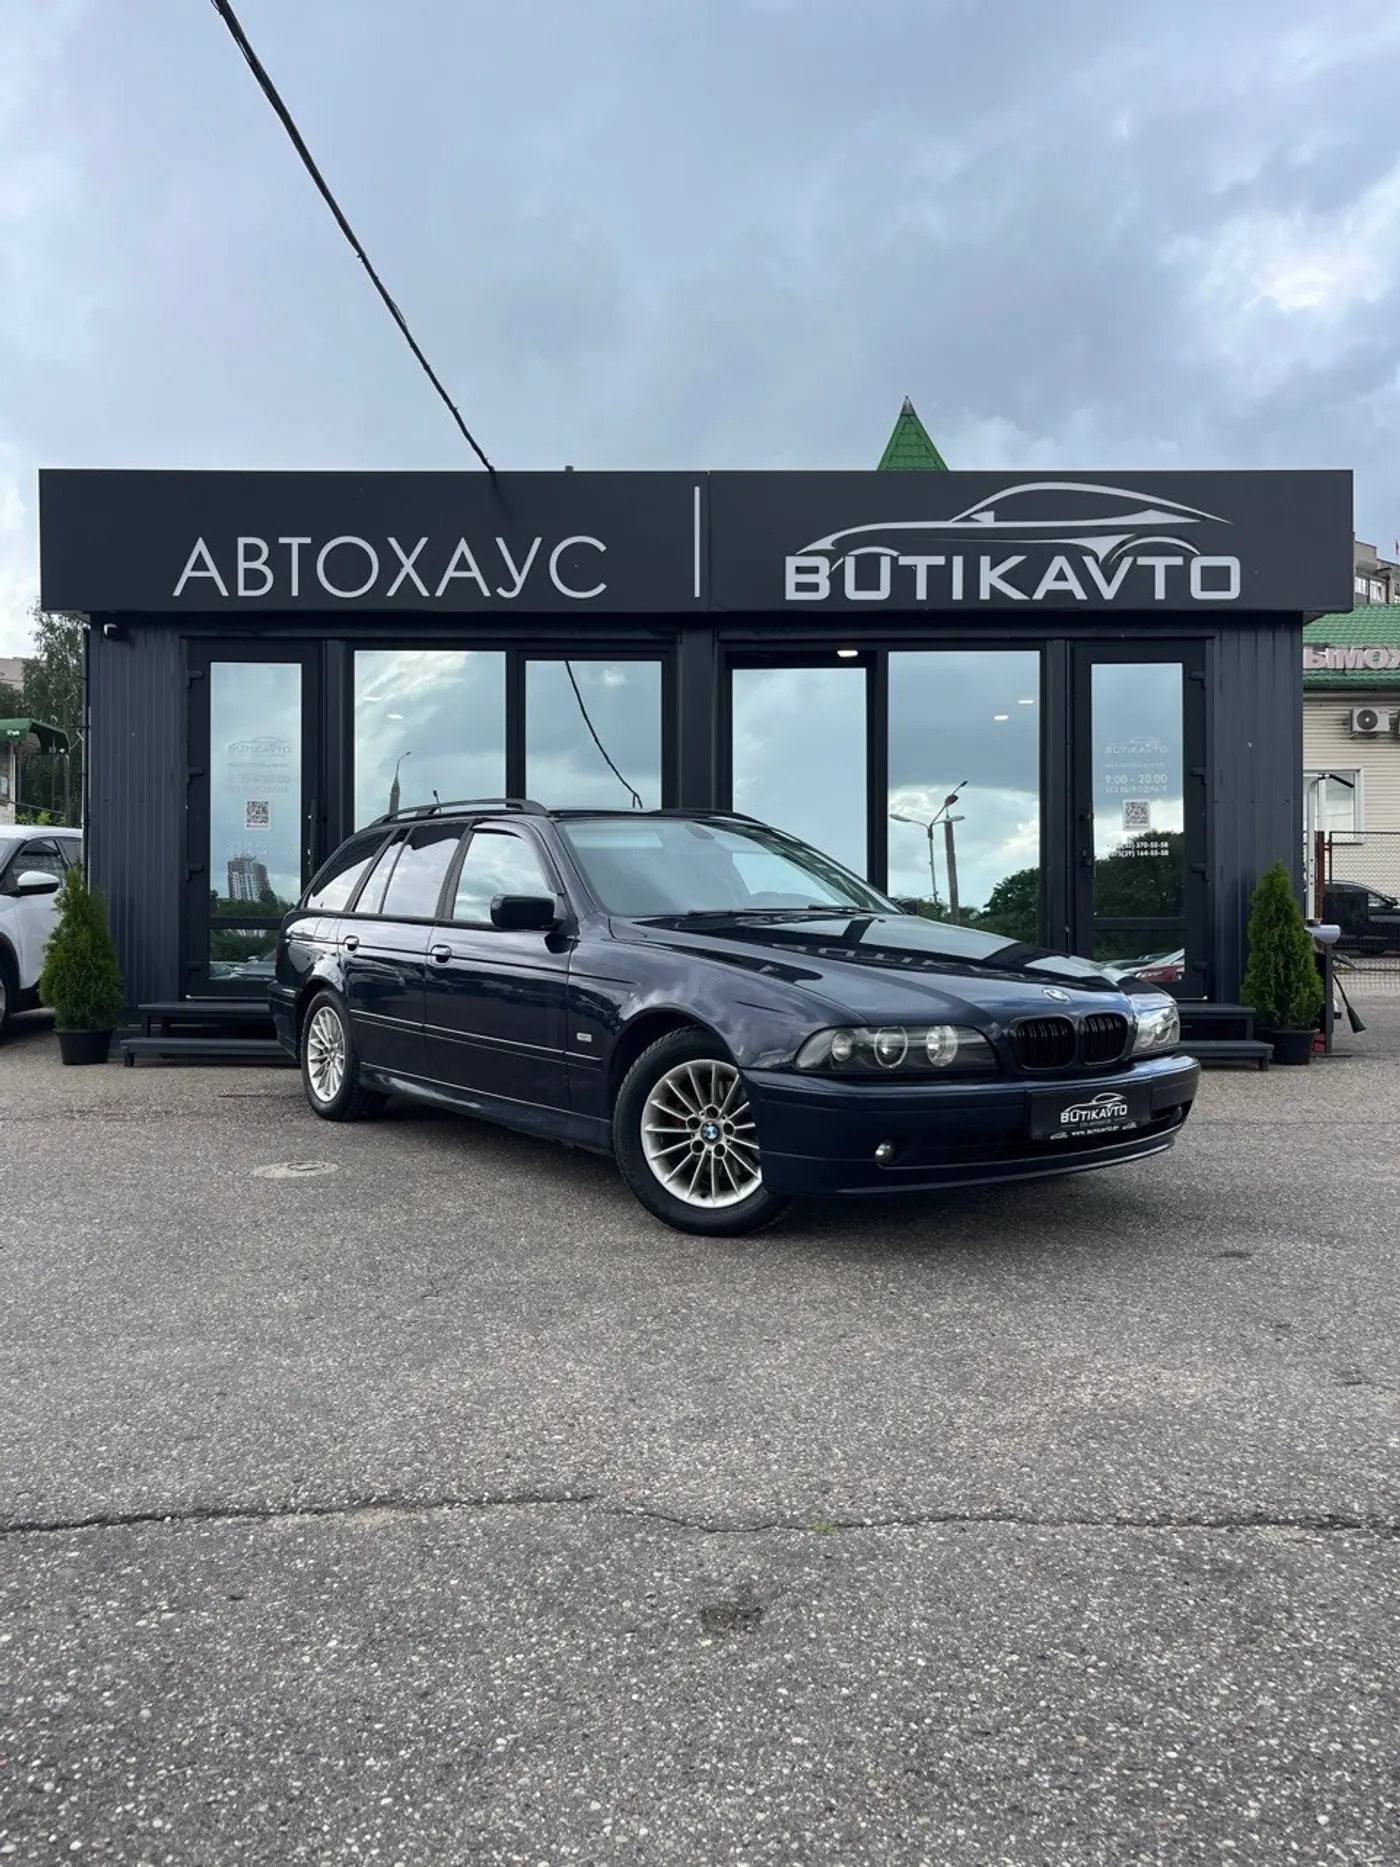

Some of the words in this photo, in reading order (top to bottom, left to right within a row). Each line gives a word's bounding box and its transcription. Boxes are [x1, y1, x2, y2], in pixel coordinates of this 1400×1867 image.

[172, 535, 608, 599] АВТОХАУС
[785, 555, 1241, 600] BUTIKAVTO
[1060, 1104, 1128, 1123] BUTIKAVTO
